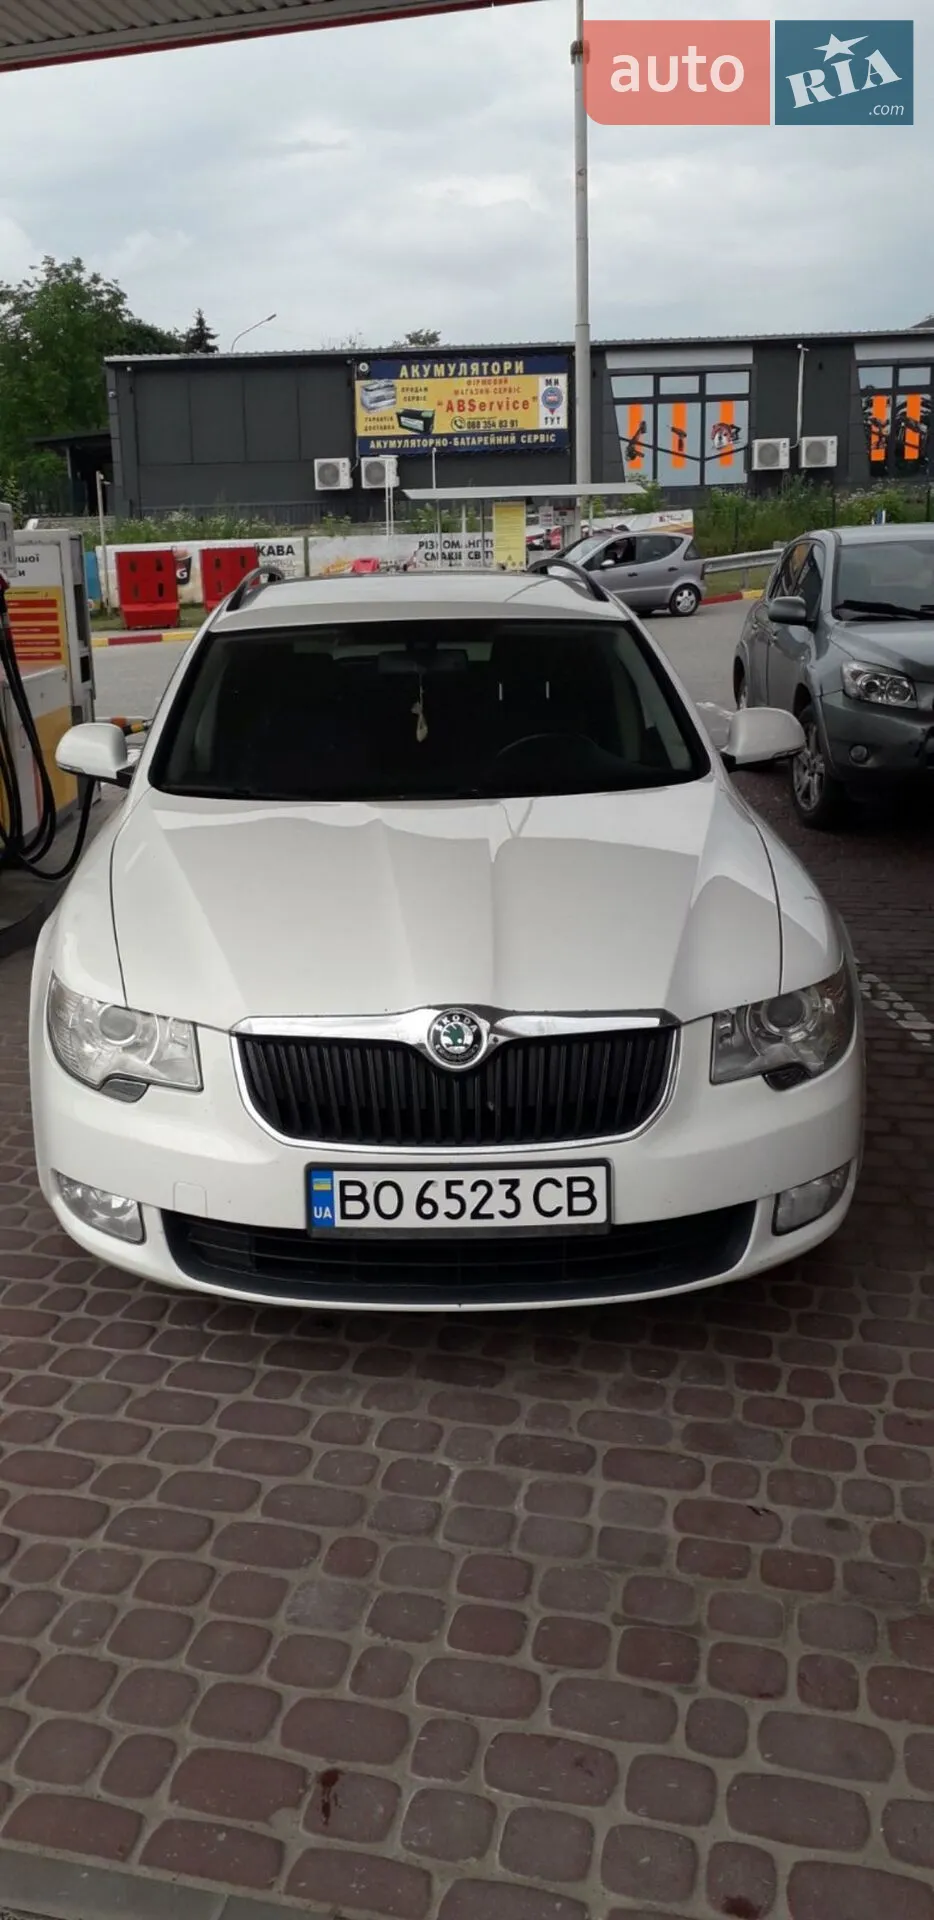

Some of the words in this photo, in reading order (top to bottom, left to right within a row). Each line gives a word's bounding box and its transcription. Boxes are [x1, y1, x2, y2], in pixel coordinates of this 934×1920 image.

[400, 361, 525, 379] АКУМУЛЯТОРИ
[545, 378, 560, 386] МИ
[544, 416, 561, 425] ТУТ
[520, 434, 557, 444] СЕРВІС
[338, 1179, 405, 1221] BO
[415, 1177, 522, 1220] 6523
[532, 1175, 598, 1219] CB
[313, 1205, 333, 1219] UA
